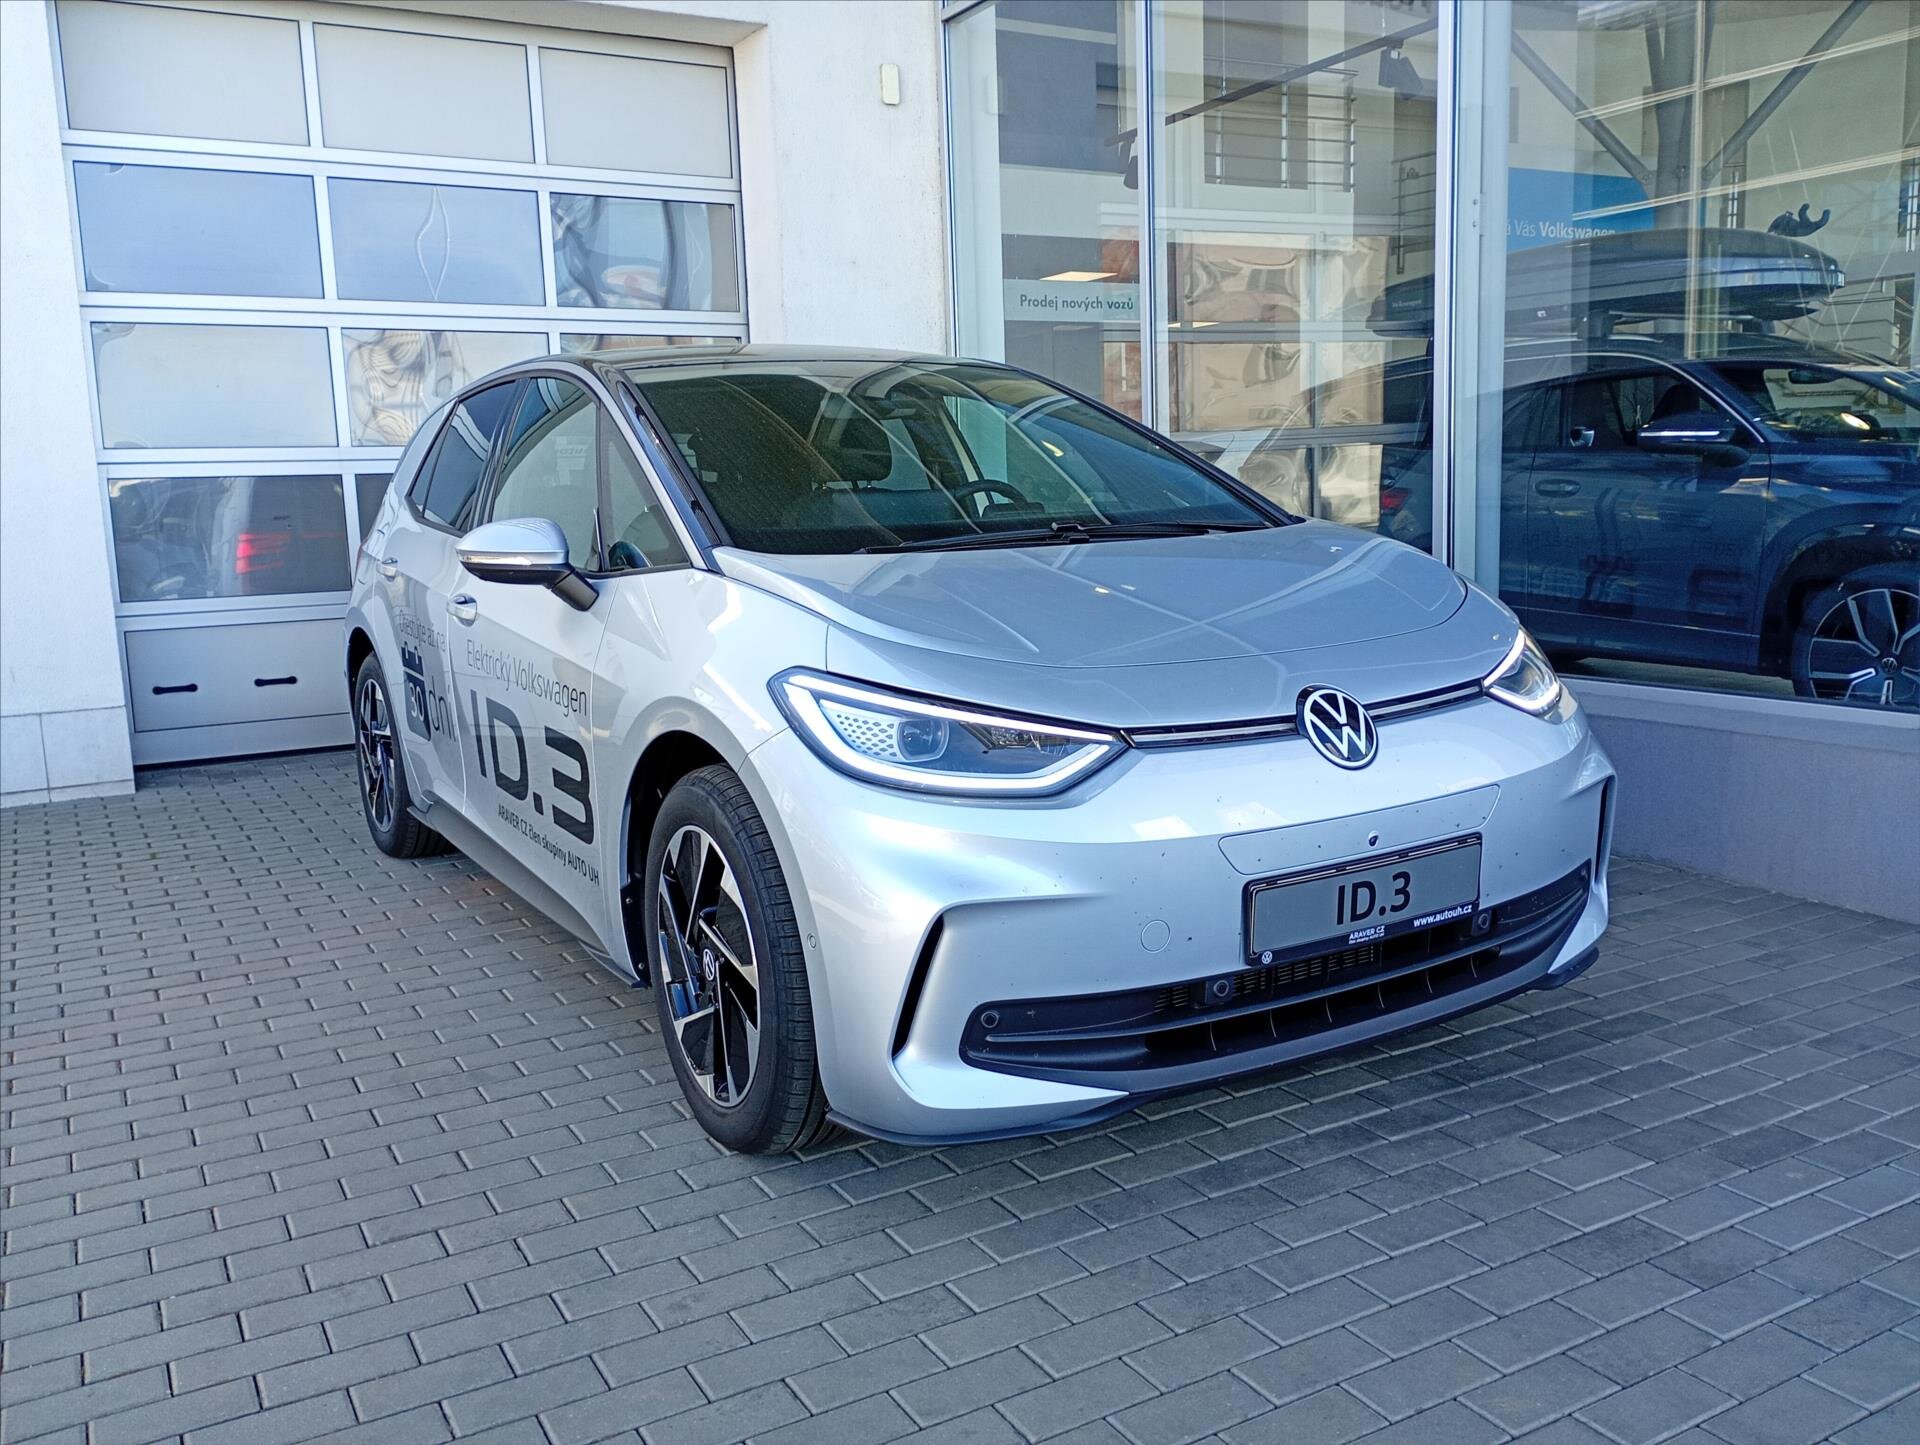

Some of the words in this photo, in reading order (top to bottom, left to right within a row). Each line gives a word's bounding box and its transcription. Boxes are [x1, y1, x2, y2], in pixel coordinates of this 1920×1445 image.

[1514, 219, 1537, 237] Vás
[1020, 294, 1058, 311] Prodej
[1062, 295, 1103, 312] nových
[1106, 297, 1134, 310] vozů
[467, 639, 511, 691] Elektrický
[513, 657, 587, 717] Volkswagen
[410, 682, 425, 721] 30
[470, 689, 594, 845] ID.3
[520, 818, 529, 837] CZ
[568, 849, 587, 877] AUTO
[588, 863, 600, 887] UH
[1336, 871, 1411, 925] ID.3
[1413, 904, 1472, 928] www.autouh.cz
[1349, 928, 1375, 940] ARAVER
[1376, 925, 1385, 933] CZ
